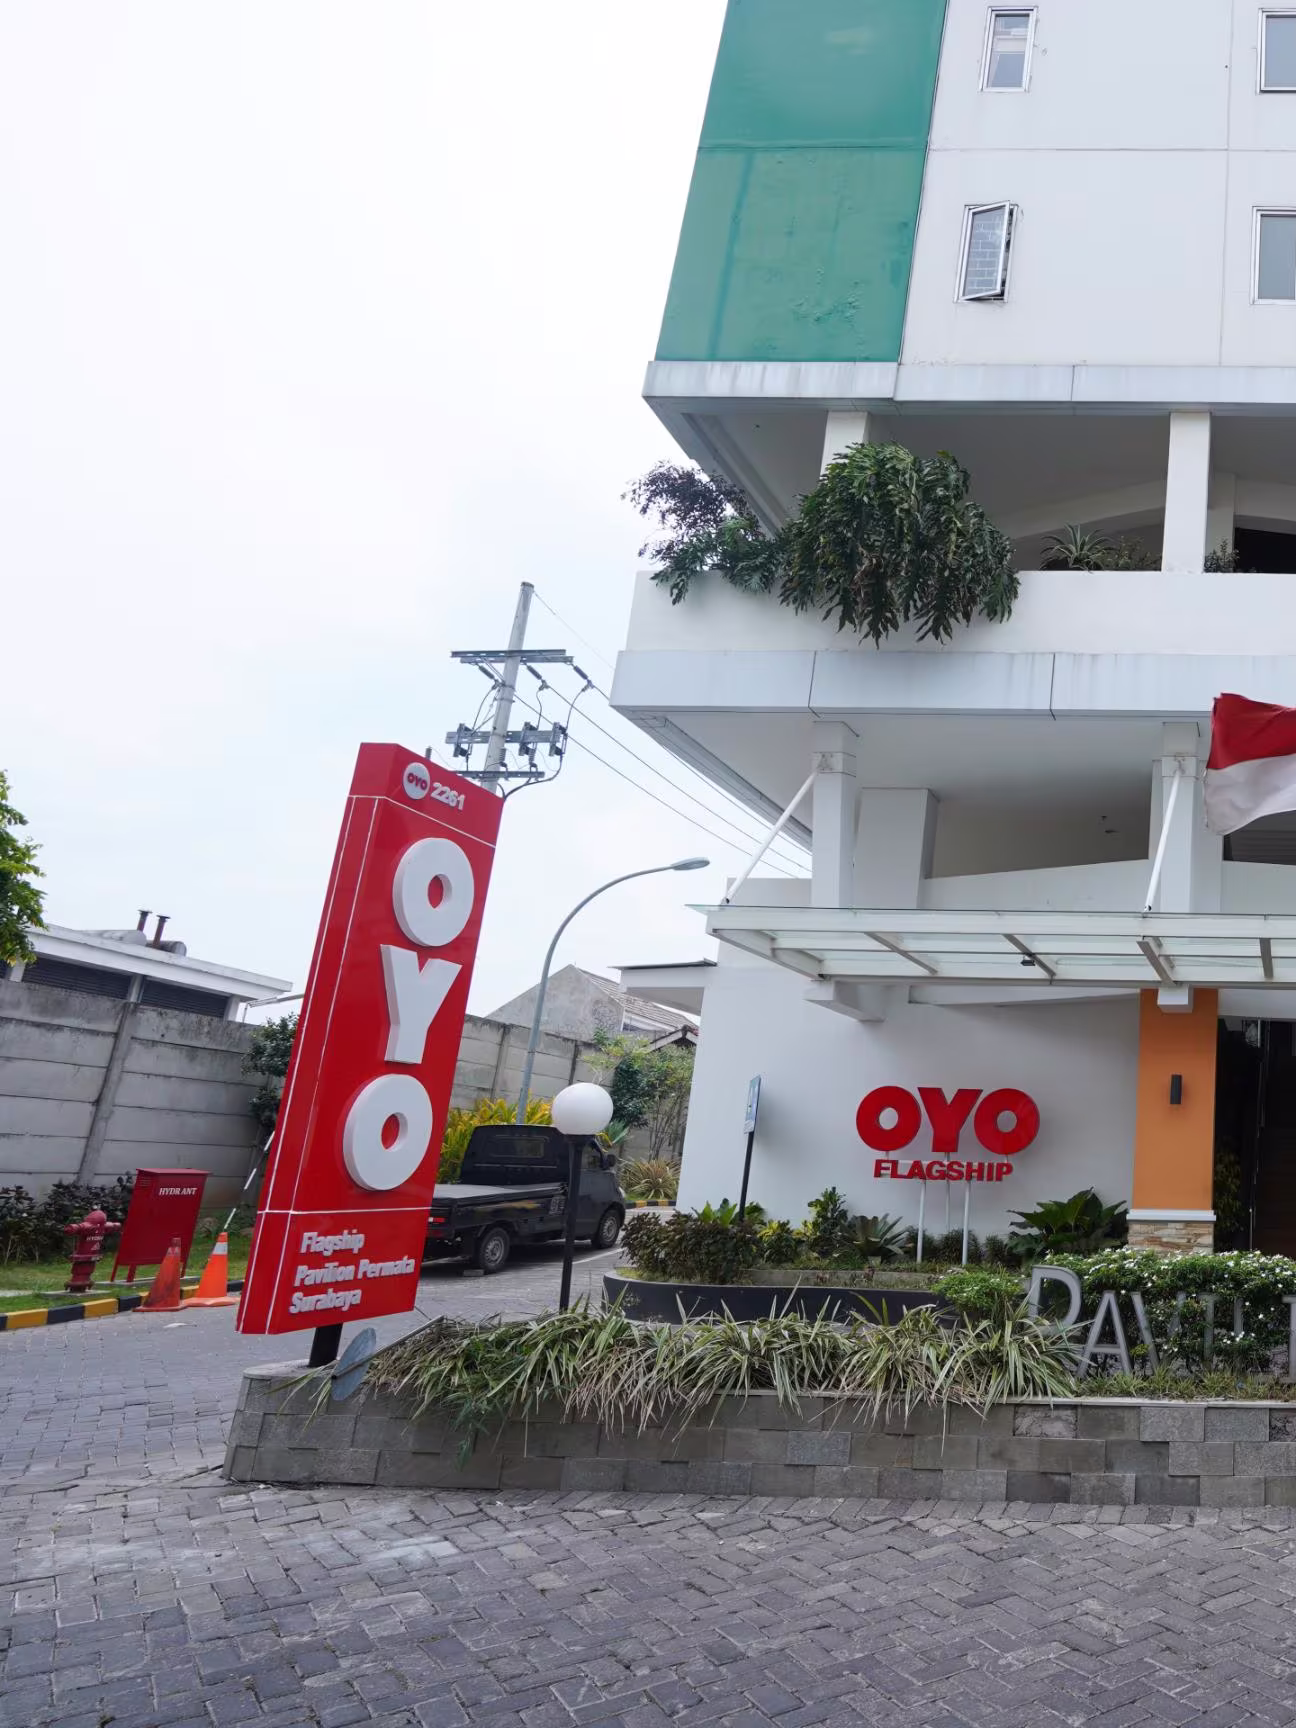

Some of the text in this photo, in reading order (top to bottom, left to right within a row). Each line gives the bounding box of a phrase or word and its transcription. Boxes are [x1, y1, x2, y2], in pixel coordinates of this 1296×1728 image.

[430, 782, 465, 810] 2261
[343, 837, 475, 1191] OYO
[856, 1085, 1041, 1155] OYO
[873, 1159, 1014, 1182] FLAGSHIP
[158, 1187, 198, 1196] HYDRANT
[300, 1229, 365, 1256] Flagship
[294, 1255, 416, 1287] Pavilion Permata
[289, 1288, 362, 1314] Surabaya
